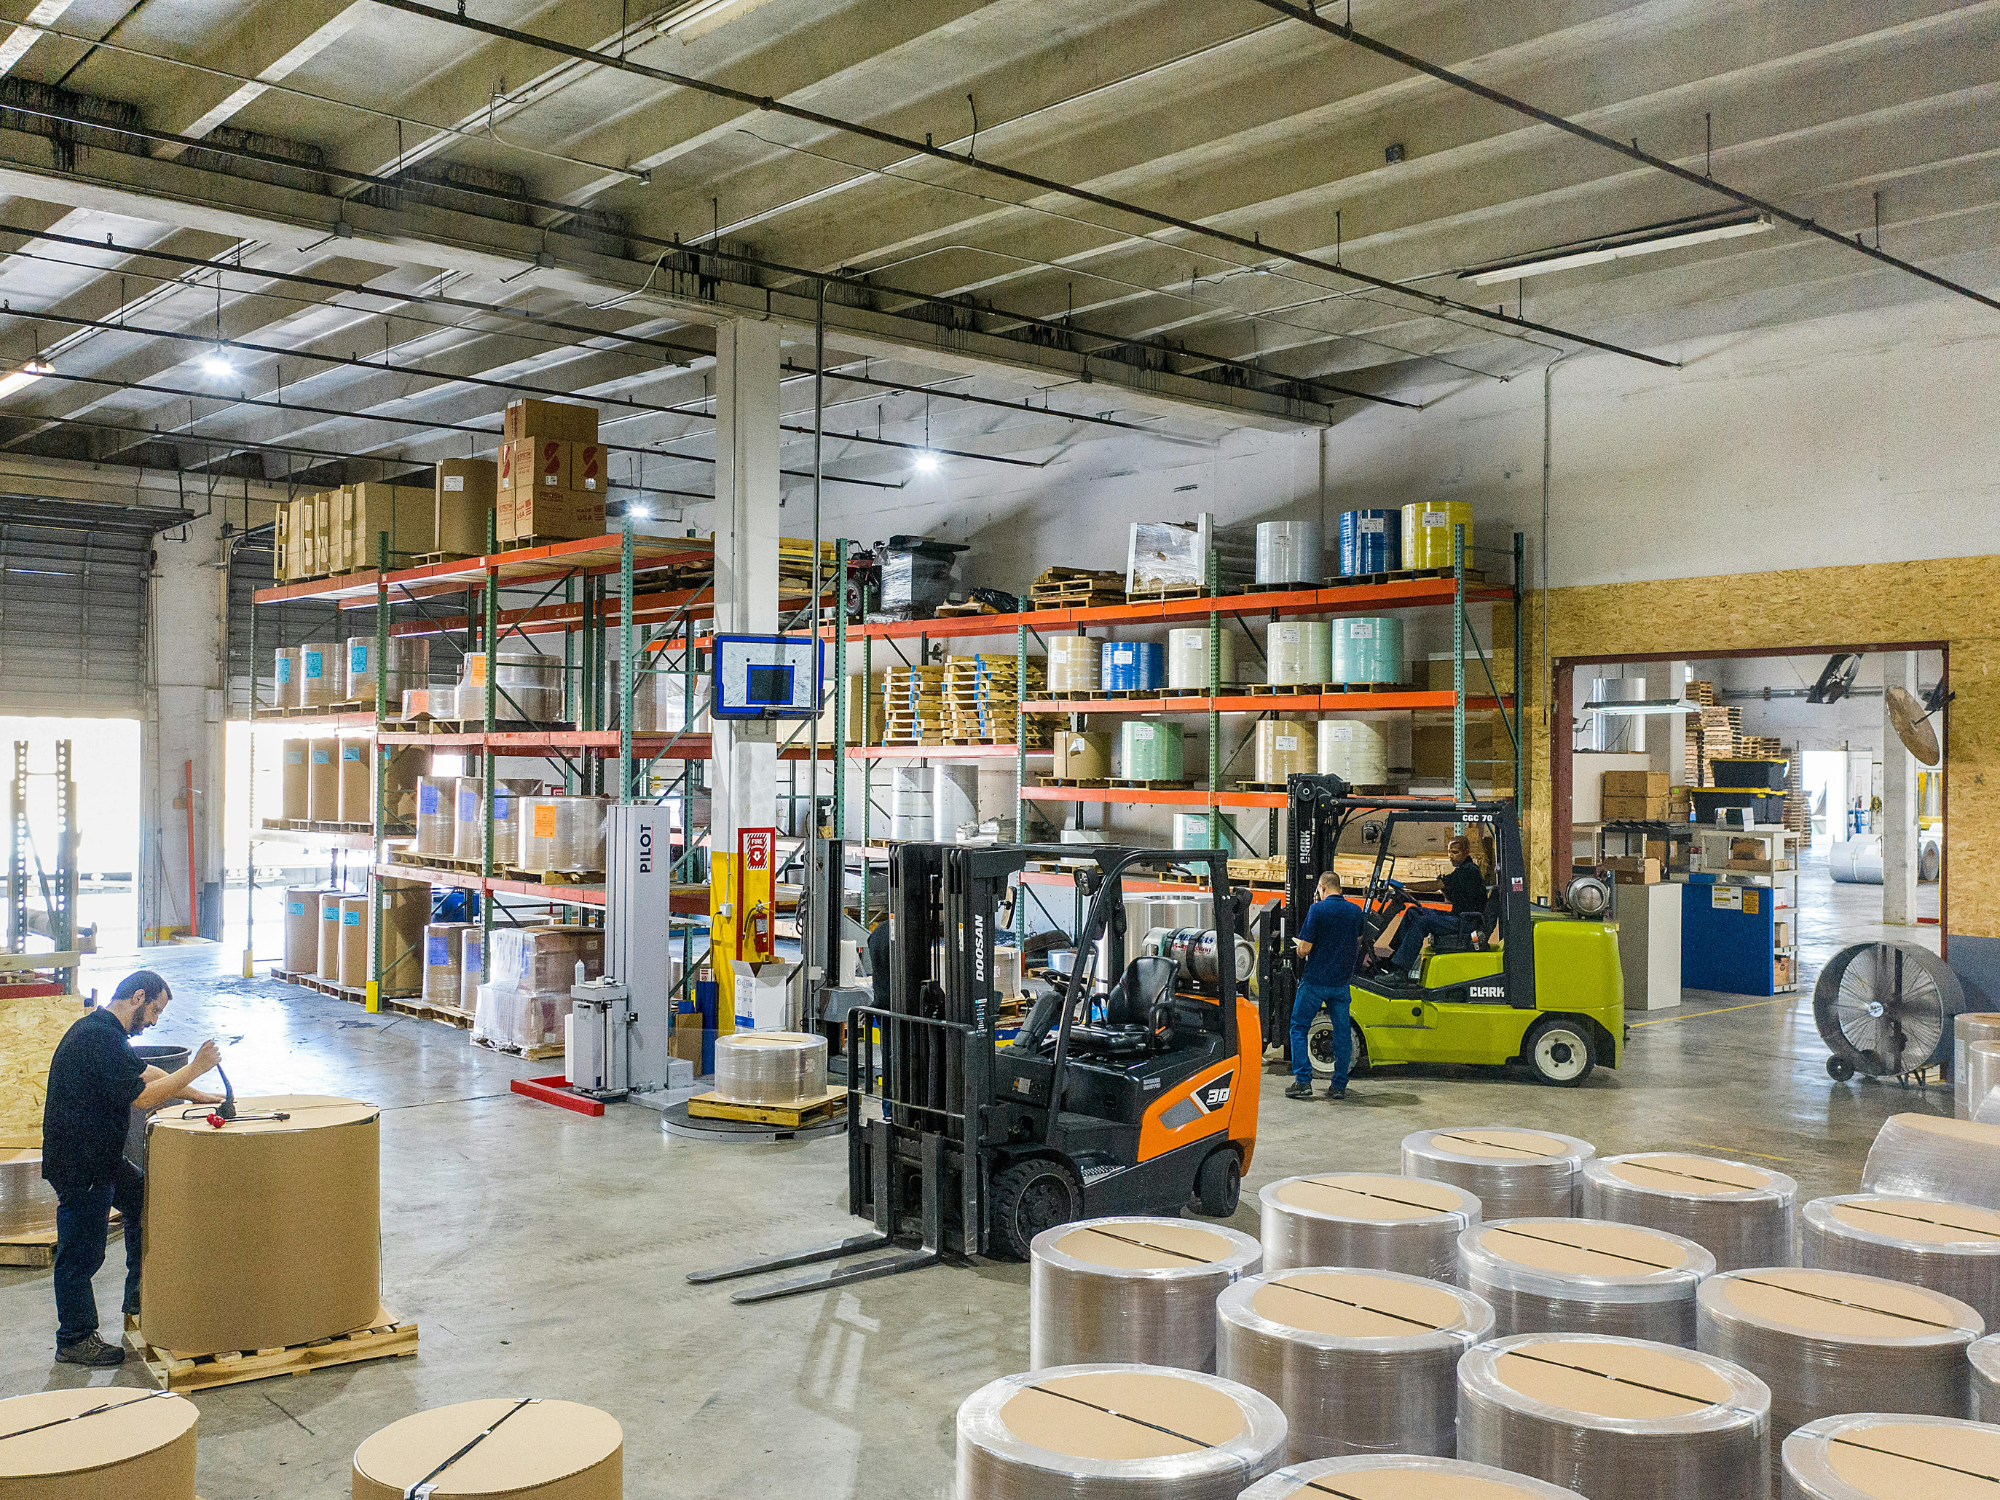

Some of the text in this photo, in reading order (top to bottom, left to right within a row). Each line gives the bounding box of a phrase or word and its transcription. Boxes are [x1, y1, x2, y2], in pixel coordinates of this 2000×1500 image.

[1462, 814, 1493, 822] CGC 70
[640, 824, 651, 873] PILOT
[1300, 830, 1311, 864] CLARK
[975, 914, 984, 982] DOOSAN
[1469, 986, 1505, 998] CLARK
[1206, 1088, 1231, 1104] 30
